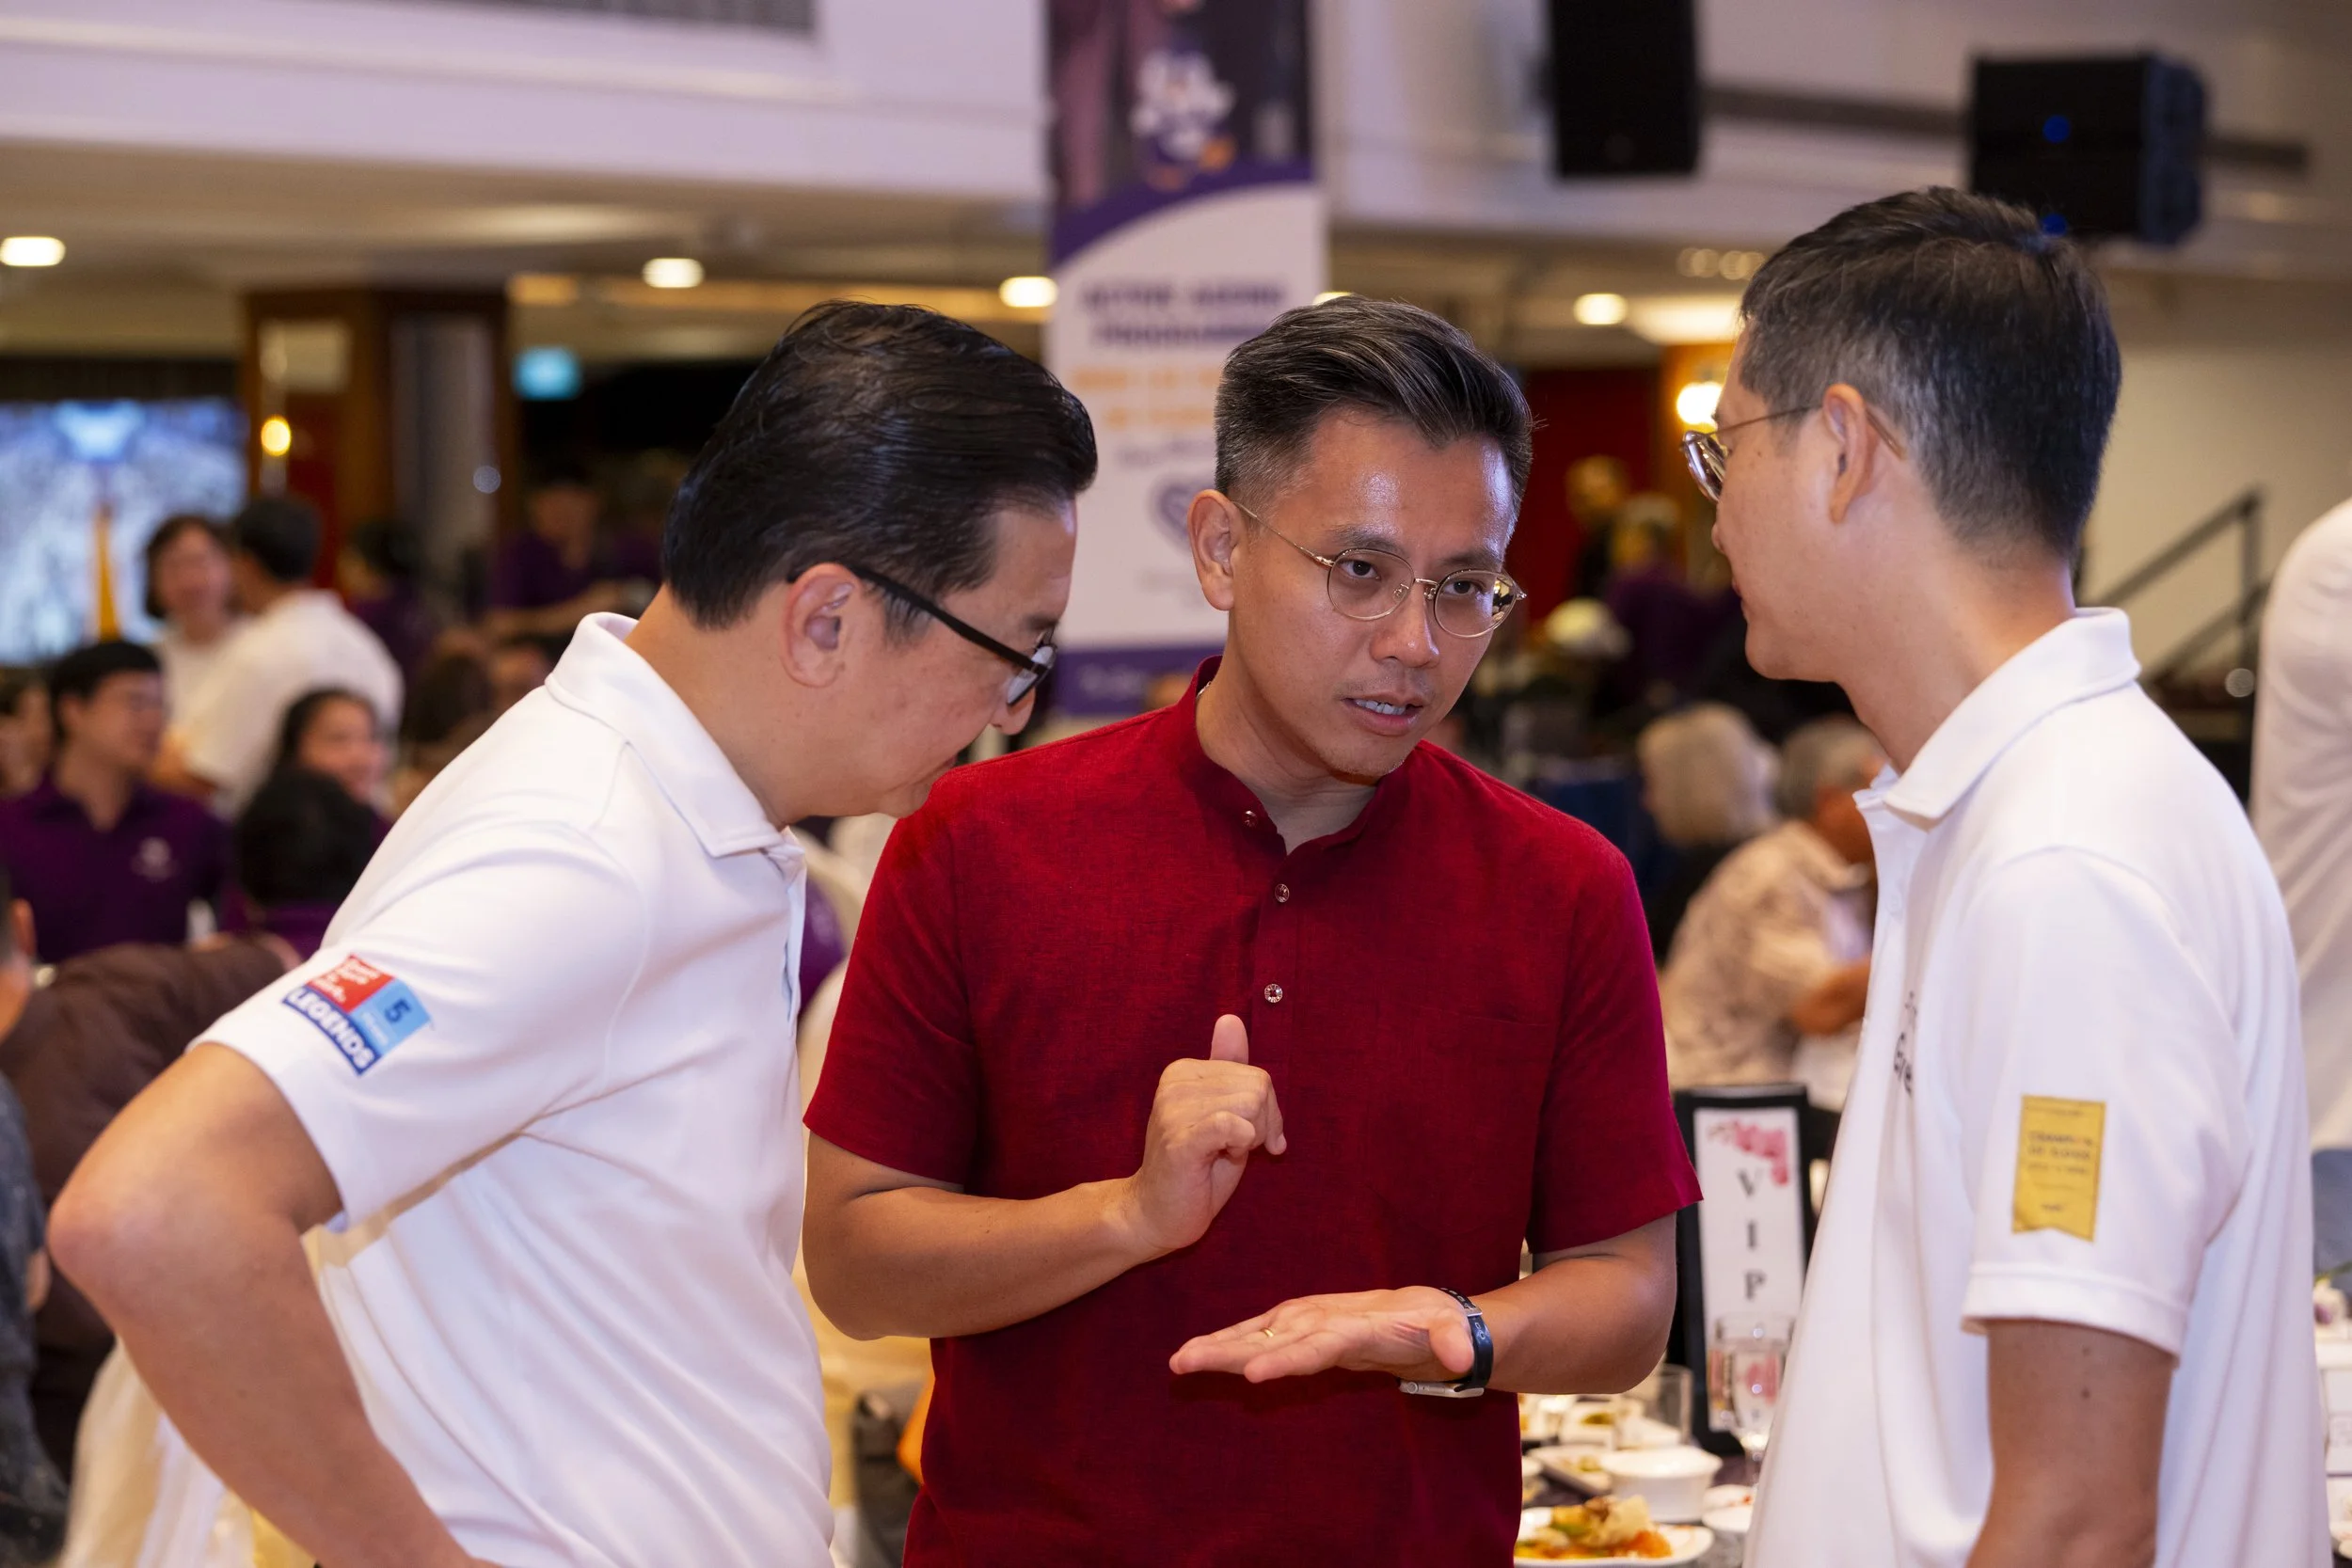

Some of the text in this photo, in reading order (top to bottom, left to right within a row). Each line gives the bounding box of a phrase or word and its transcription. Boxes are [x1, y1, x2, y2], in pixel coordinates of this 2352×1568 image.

[284, 988, 376, 1069] LEGENDS
[385, 998, 411, 1023] 5
[1737, 1167, 1767, 1300] VIP
